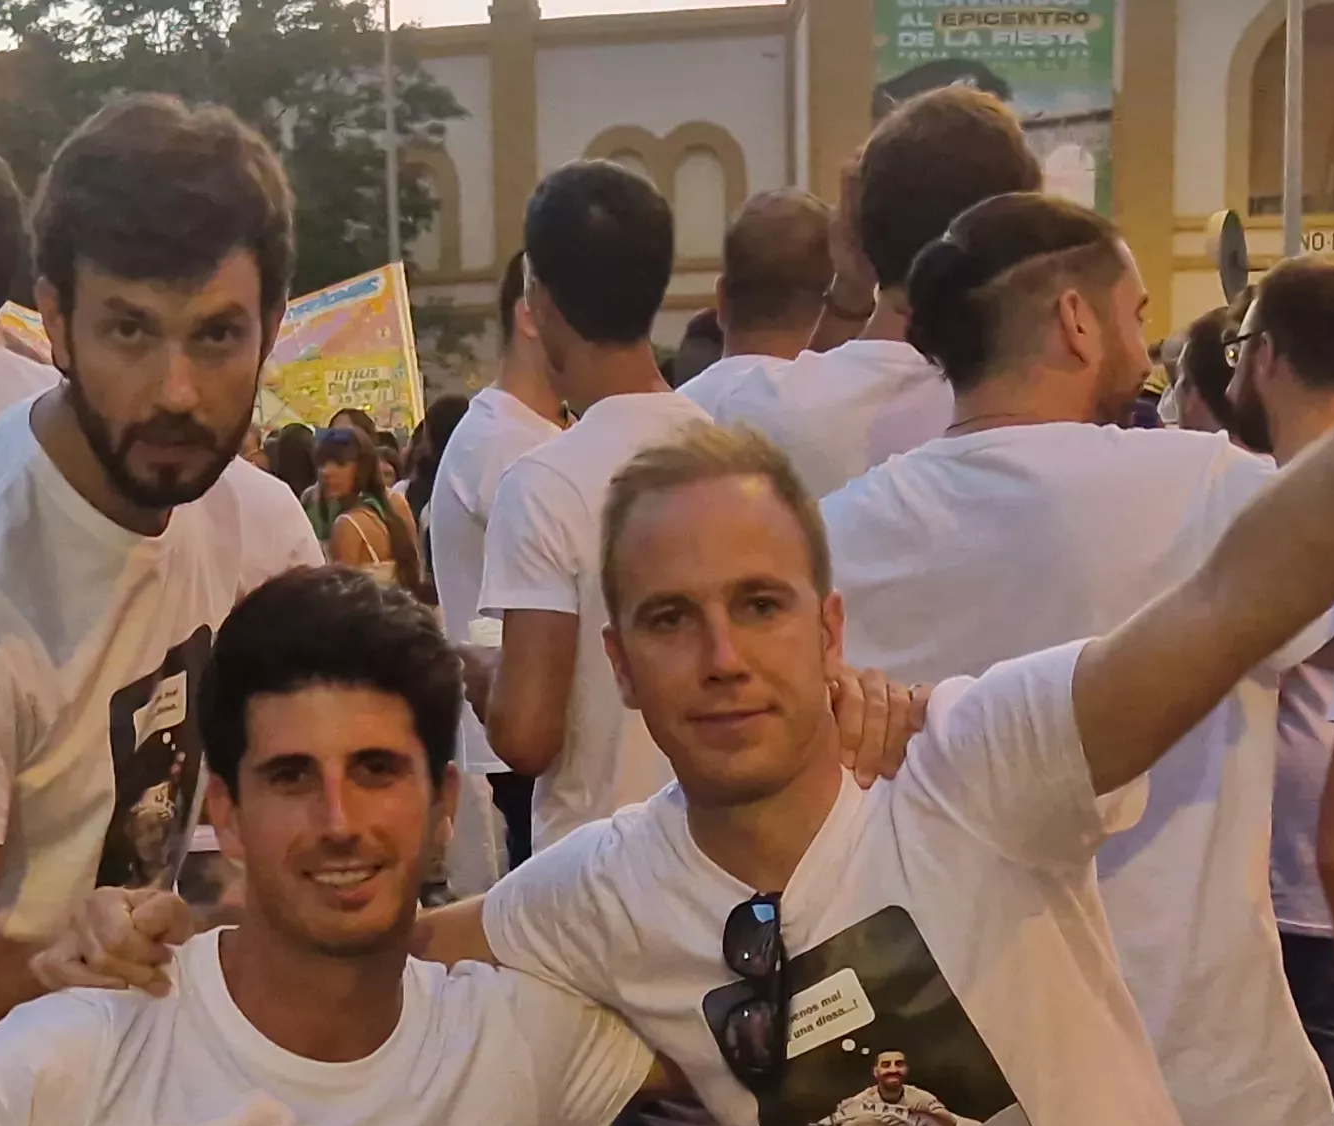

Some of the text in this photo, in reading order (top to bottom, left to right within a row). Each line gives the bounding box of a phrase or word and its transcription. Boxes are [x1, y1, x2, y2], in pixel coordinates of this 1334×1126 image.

[898, 11, 1090, 27] AL EPICENTRO
[898, 30, 1089, 48] DE LA FIESTA
